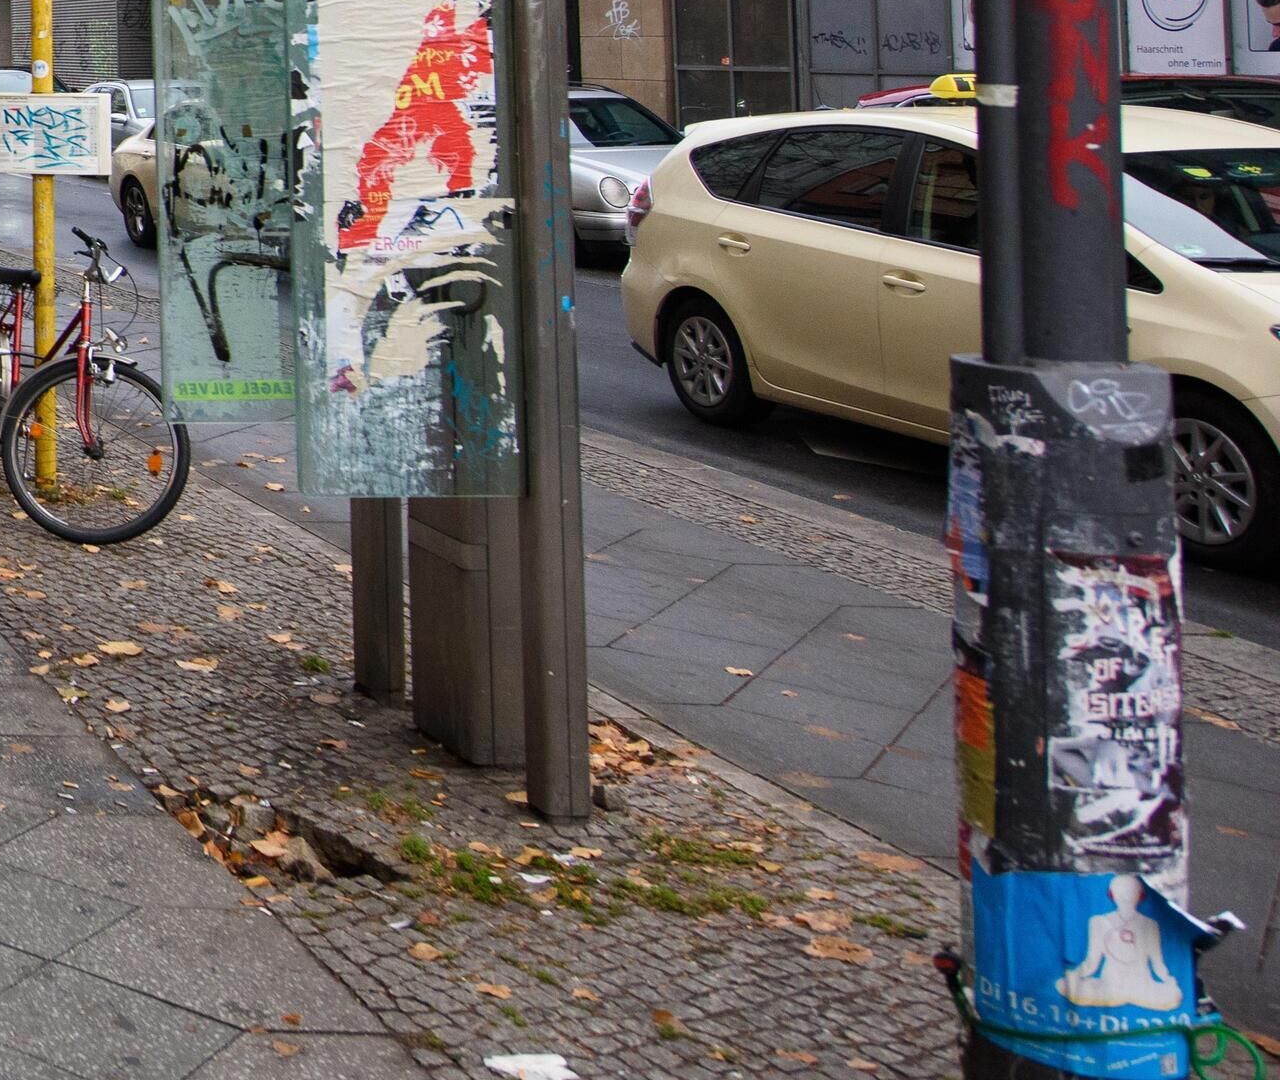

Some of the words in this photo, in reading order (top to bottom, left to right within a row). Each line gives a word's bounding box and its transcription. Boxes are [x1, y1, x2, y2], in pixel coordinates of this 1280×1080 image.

[1136, 44, 1184, 54] Haarschnitt
[1167, 59, 1190, 68] ohne
[1191, 58, 1222, 68] Termin
